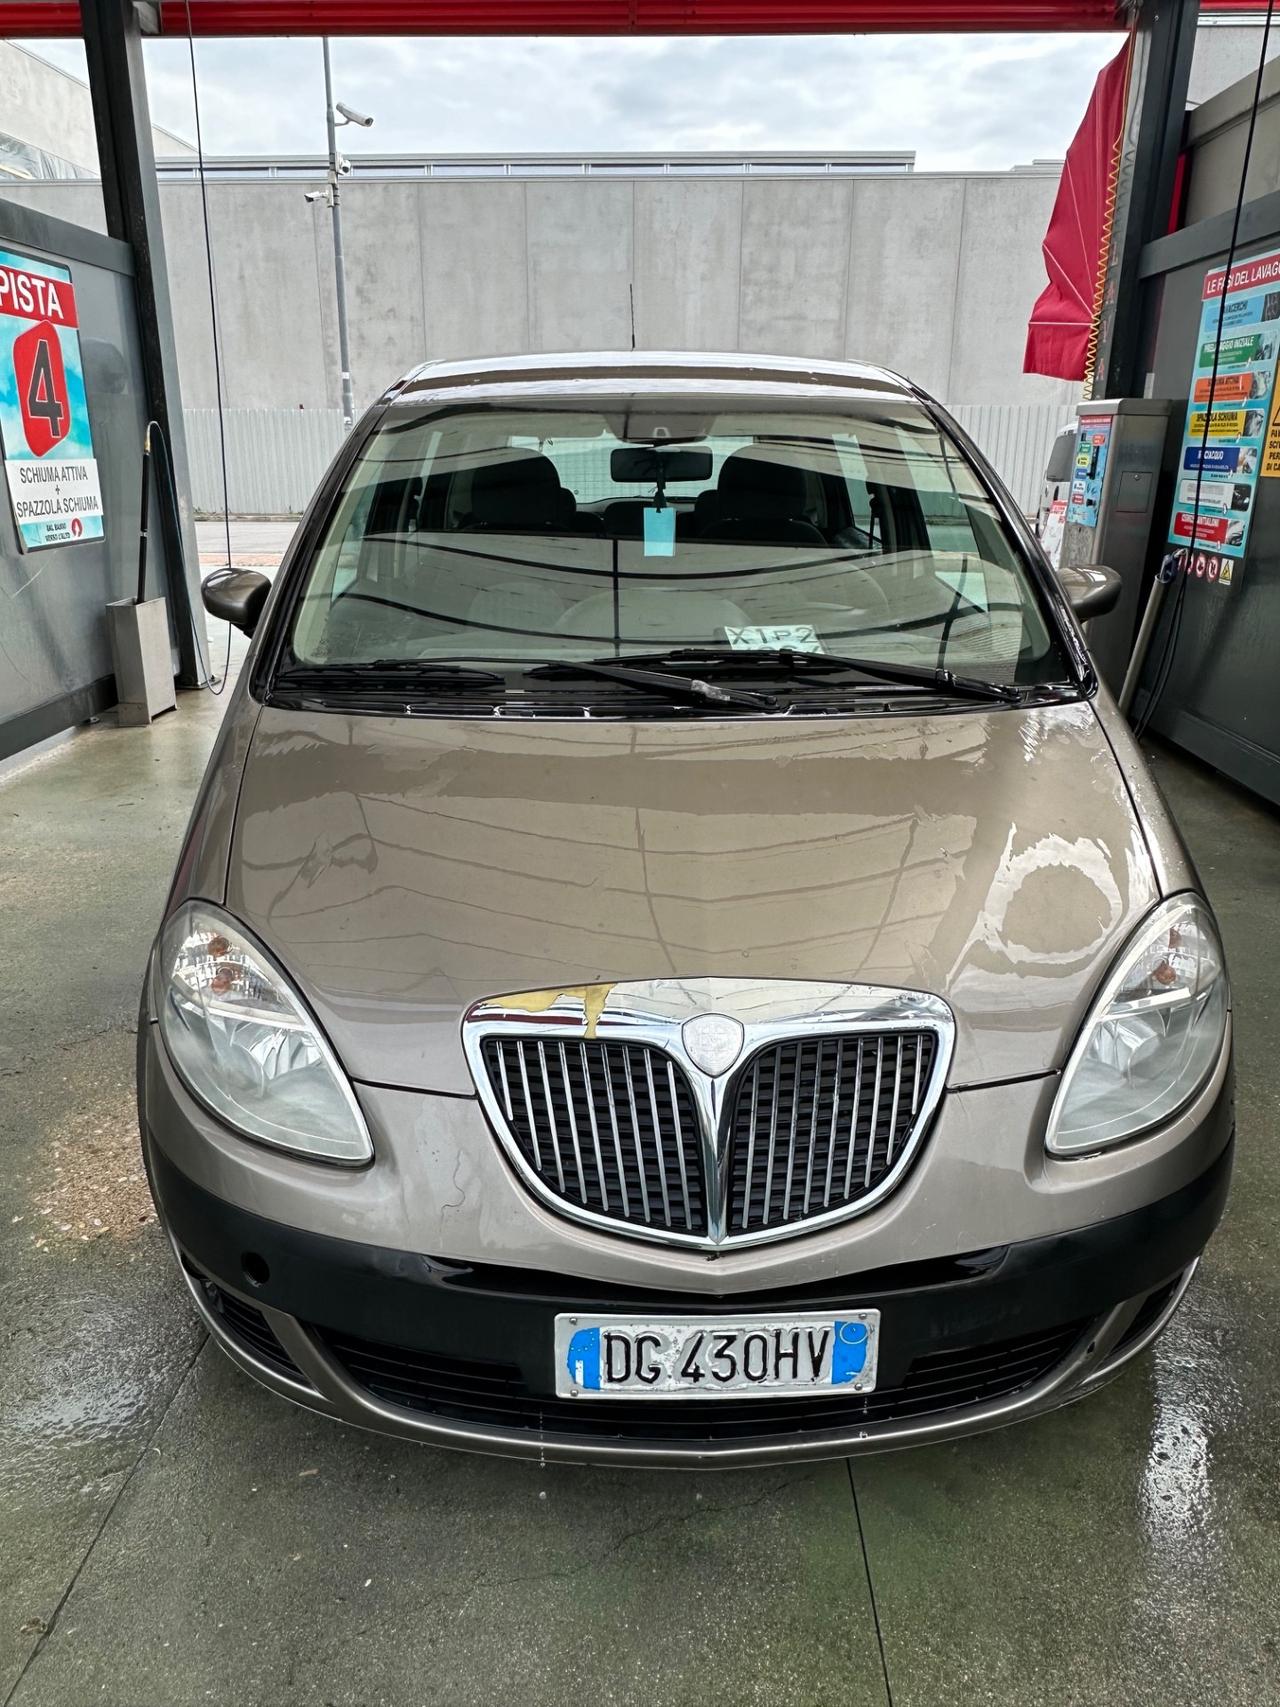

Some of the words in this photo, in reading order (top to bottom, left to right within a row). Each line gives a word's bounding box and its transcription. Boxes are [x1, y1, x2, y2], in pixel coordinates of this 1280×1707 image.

[0, 269, 64, 319] PISTA
[1207, 280, 1217, 294] LE
[1234, 271, 1250, 286] DEL
[1251, 261, 1280, 282] LAVAG
[27, 339, 63, 438] 4
[20, 466, 60, 483] SCHIUMA
[61, 466, 88, 481] ATTIVA
[16, 499, 62, 517] SPAZZOLA
[63, 496, 99, 513] SCHIUMA
[606, 1331, 662, 1383] DG
